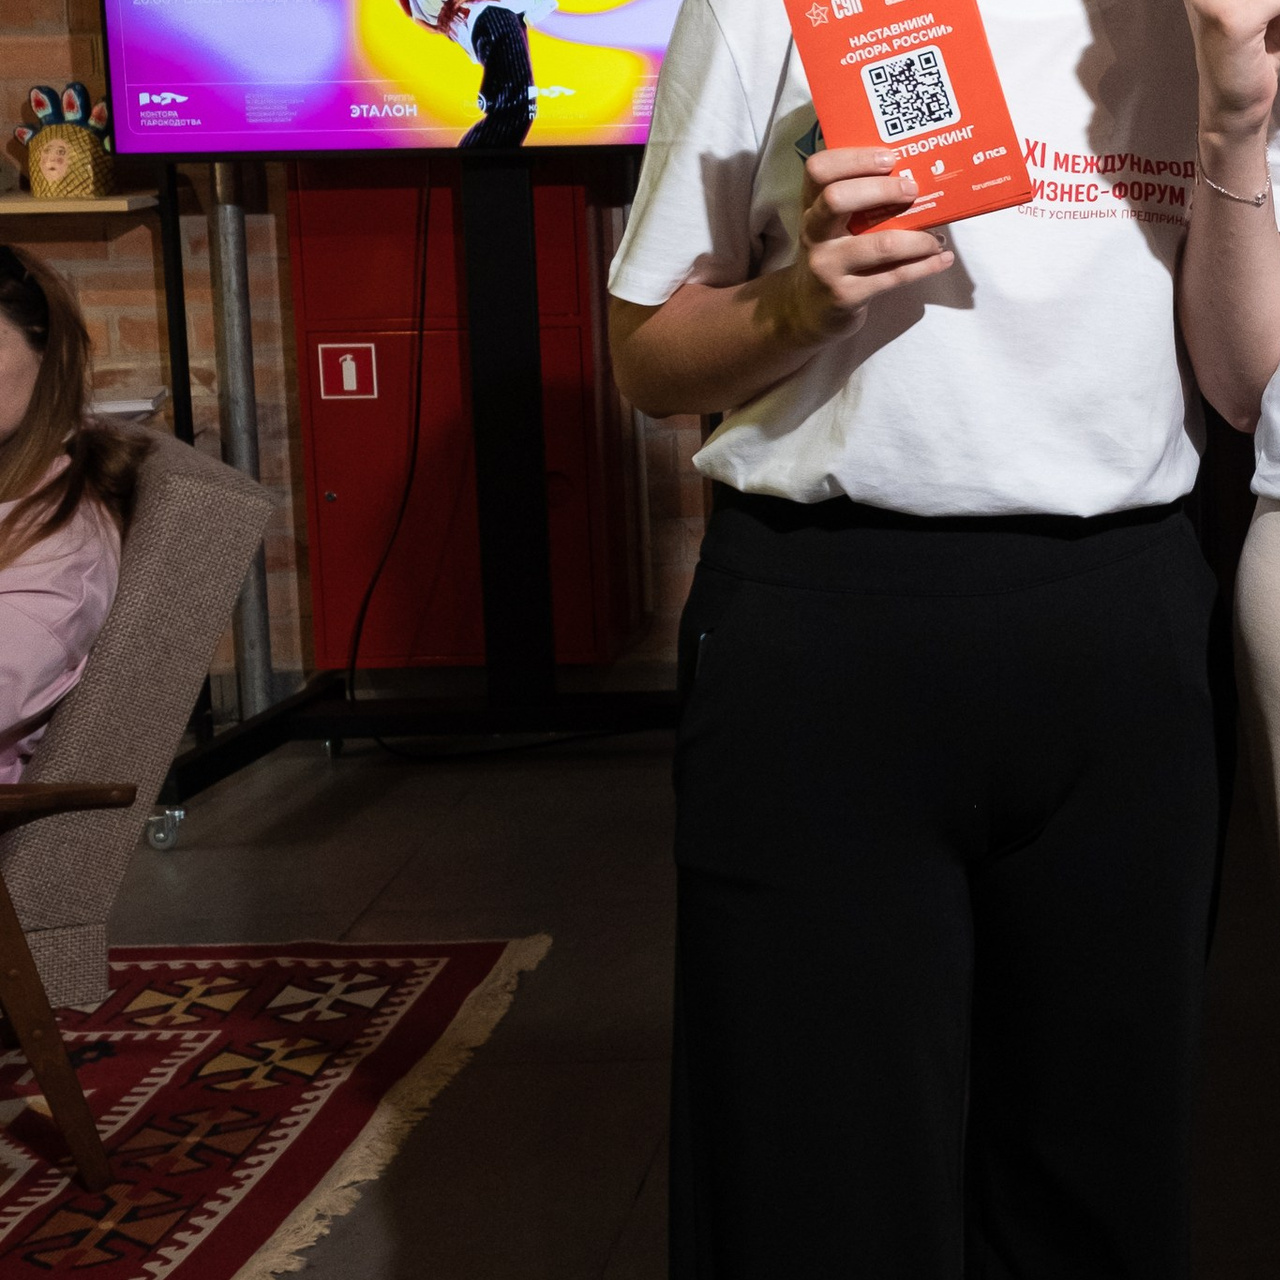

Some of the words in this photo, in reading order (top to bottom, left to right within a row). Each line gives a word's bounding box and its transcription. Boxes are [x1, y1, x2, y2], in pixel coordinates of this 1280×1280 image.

[840, 43, 891, 66] «ОПОРА
[893, 24, 954, 54] РОССИИ»
[849, 13, 936, 47] НАСТАВНИКИ
[350, 103, 418, 118] ЭТАЛОН
[891, 125, 975, 160] ЕТВОРКИНГ
[986, 146, 1008, 160] ПСБ
[1023, 138, 1047, 168] XI
[1053, 151, 1196, 179] МЕЖДУНАРОД
[1031, 178, 1186, 207] ИЗНЕС-ФОРУМ
[1049, 208, 1118, 220] УСПЕШНЫХ
